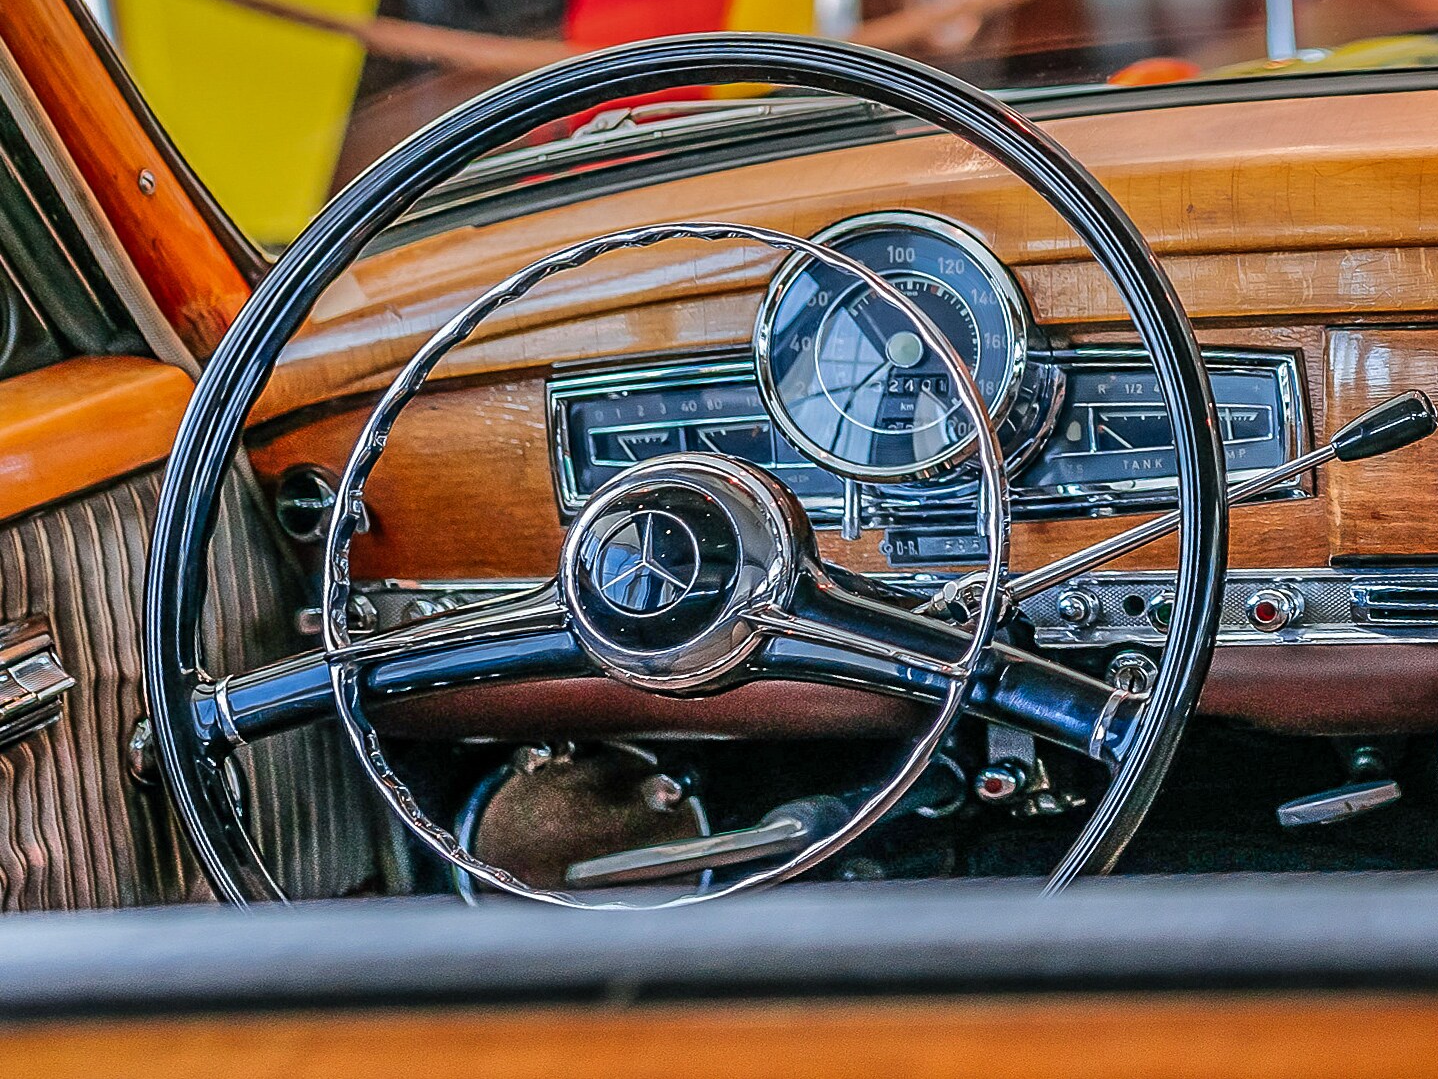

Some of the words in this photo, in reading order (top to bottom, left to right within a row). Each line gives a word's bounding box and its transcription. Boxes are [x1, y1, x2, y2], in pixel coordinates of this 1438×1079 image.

[886, 244, 916, 264] 100
[937, 257, 965, 275] 120
[790, 335, 812, 352] 40
[1098, 384, 1106, 394] R
[1124, 384, 1143, 394] 1/2
[616, 408, 622, 418] 1
[638, 405, 645, 417] 2
[660, 403, 667, 415] 3
[681, 400, 698, 412] 40
[706, 398, 723, 410] 80
[900, 402, 914, 411] km
[1122, 458, 1163, 470] TANK
